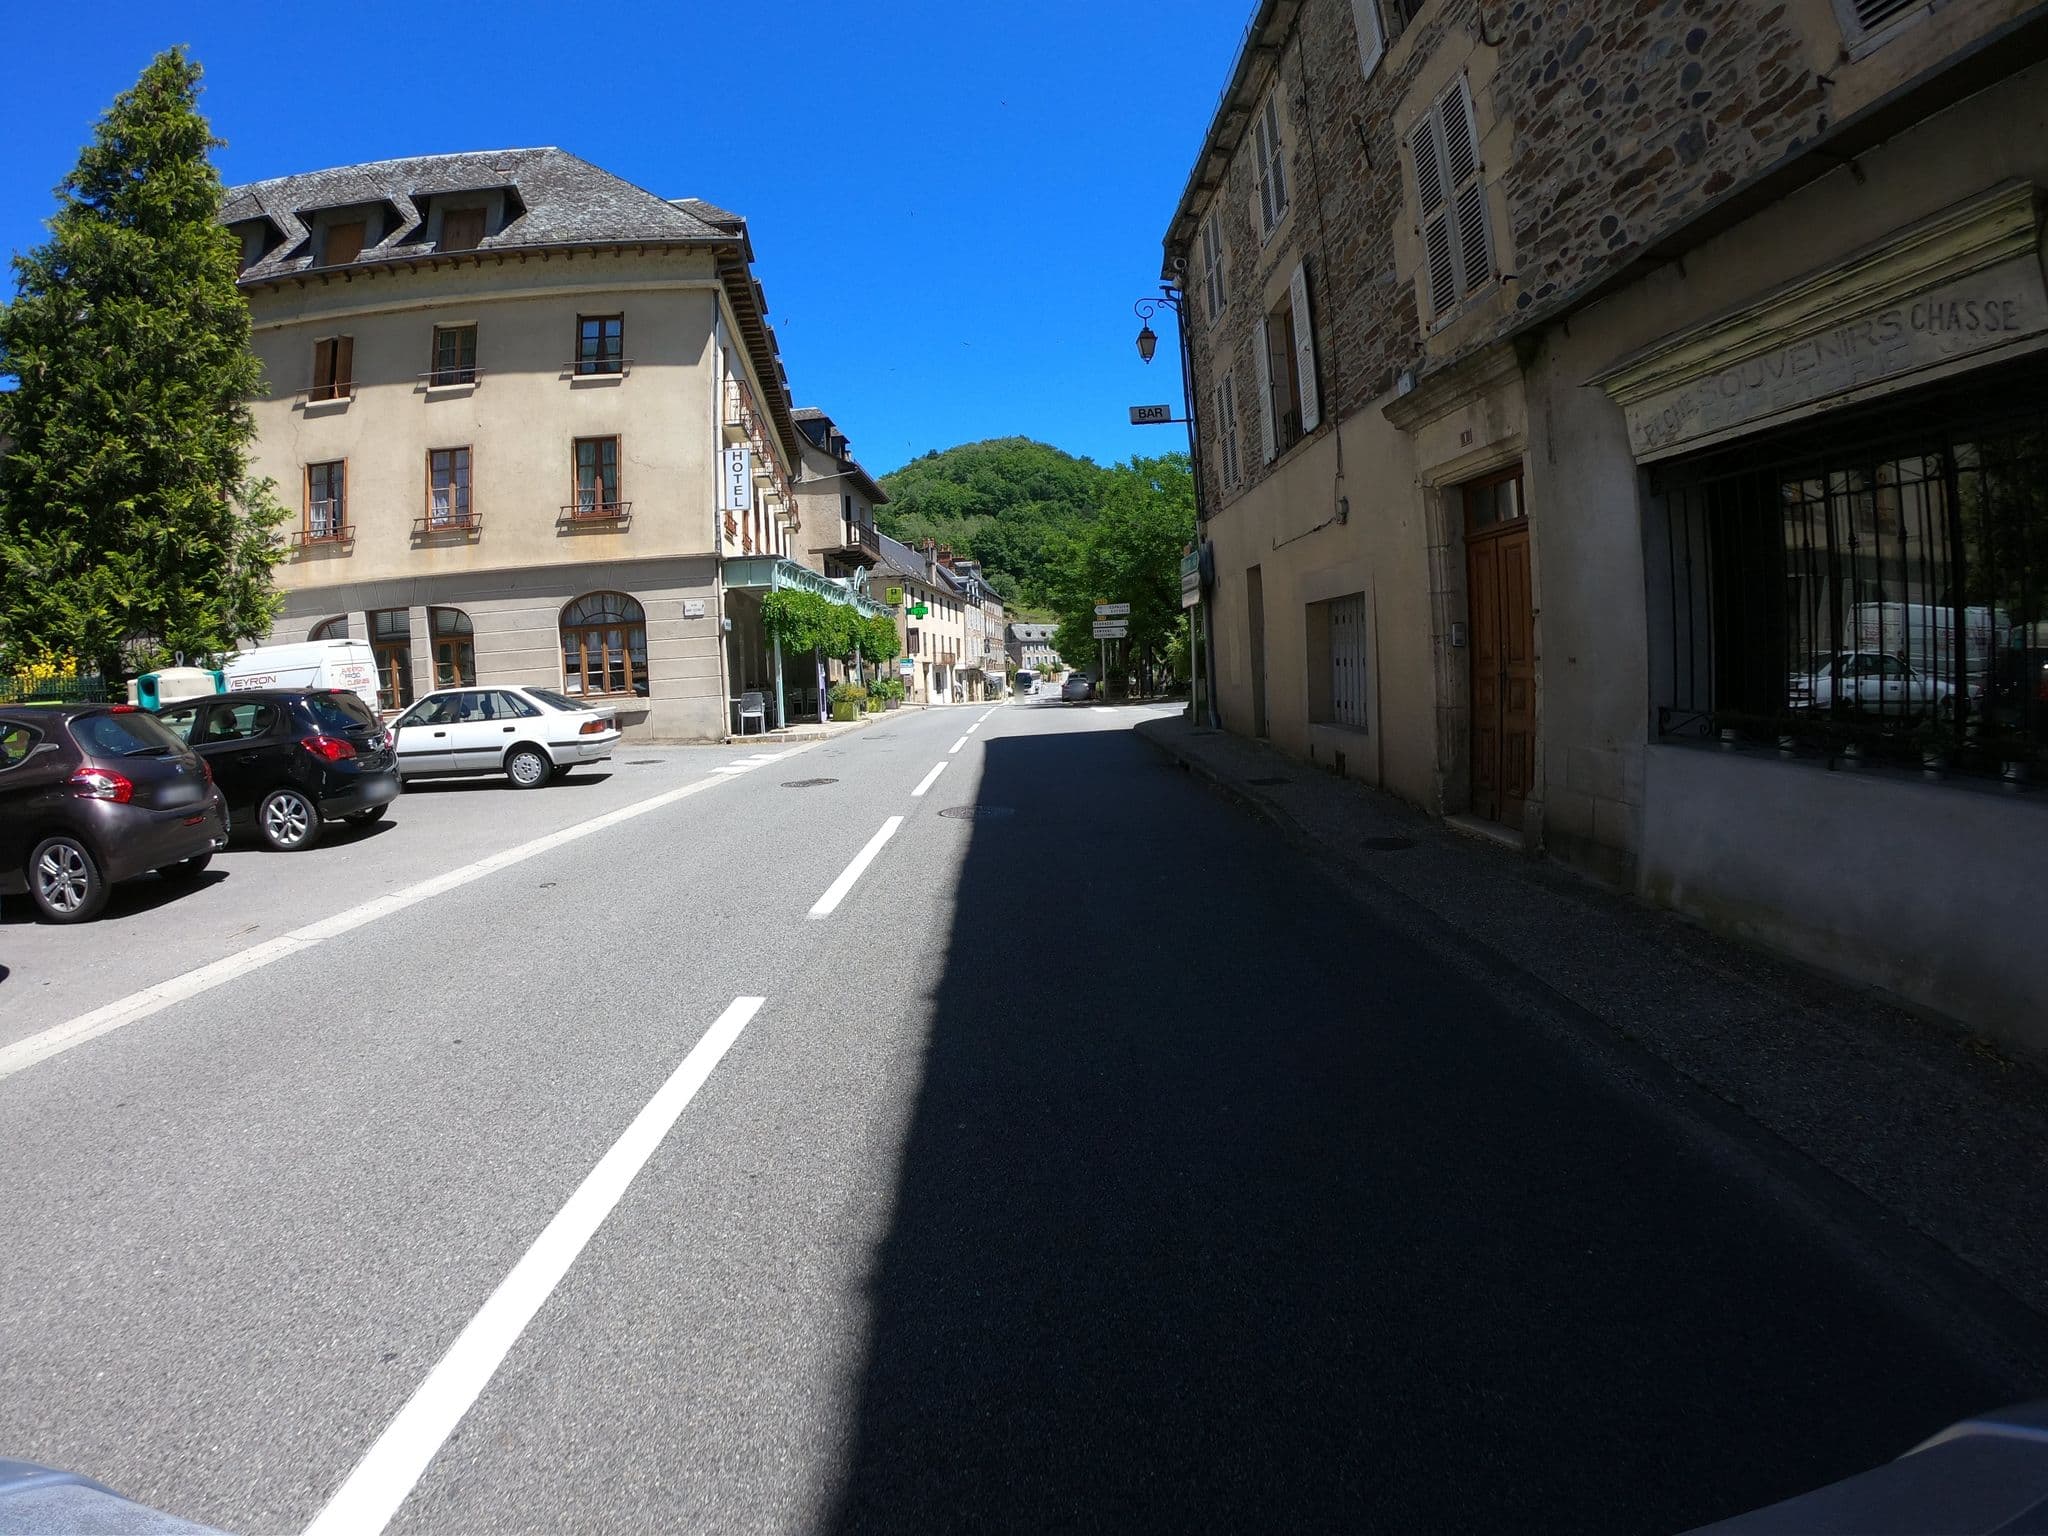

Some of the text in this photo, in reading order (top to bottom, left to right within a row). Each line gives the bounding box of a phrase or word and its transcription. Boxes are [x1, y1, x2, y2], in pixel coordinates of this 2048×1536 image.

[1696, 309, 1904, 405] SOUVENIRS
[1910, 297, 2019, 332] CHASSE
[1138, 407, 1163, 419] BAR
[732, 451, 744, 508] HOTEL
